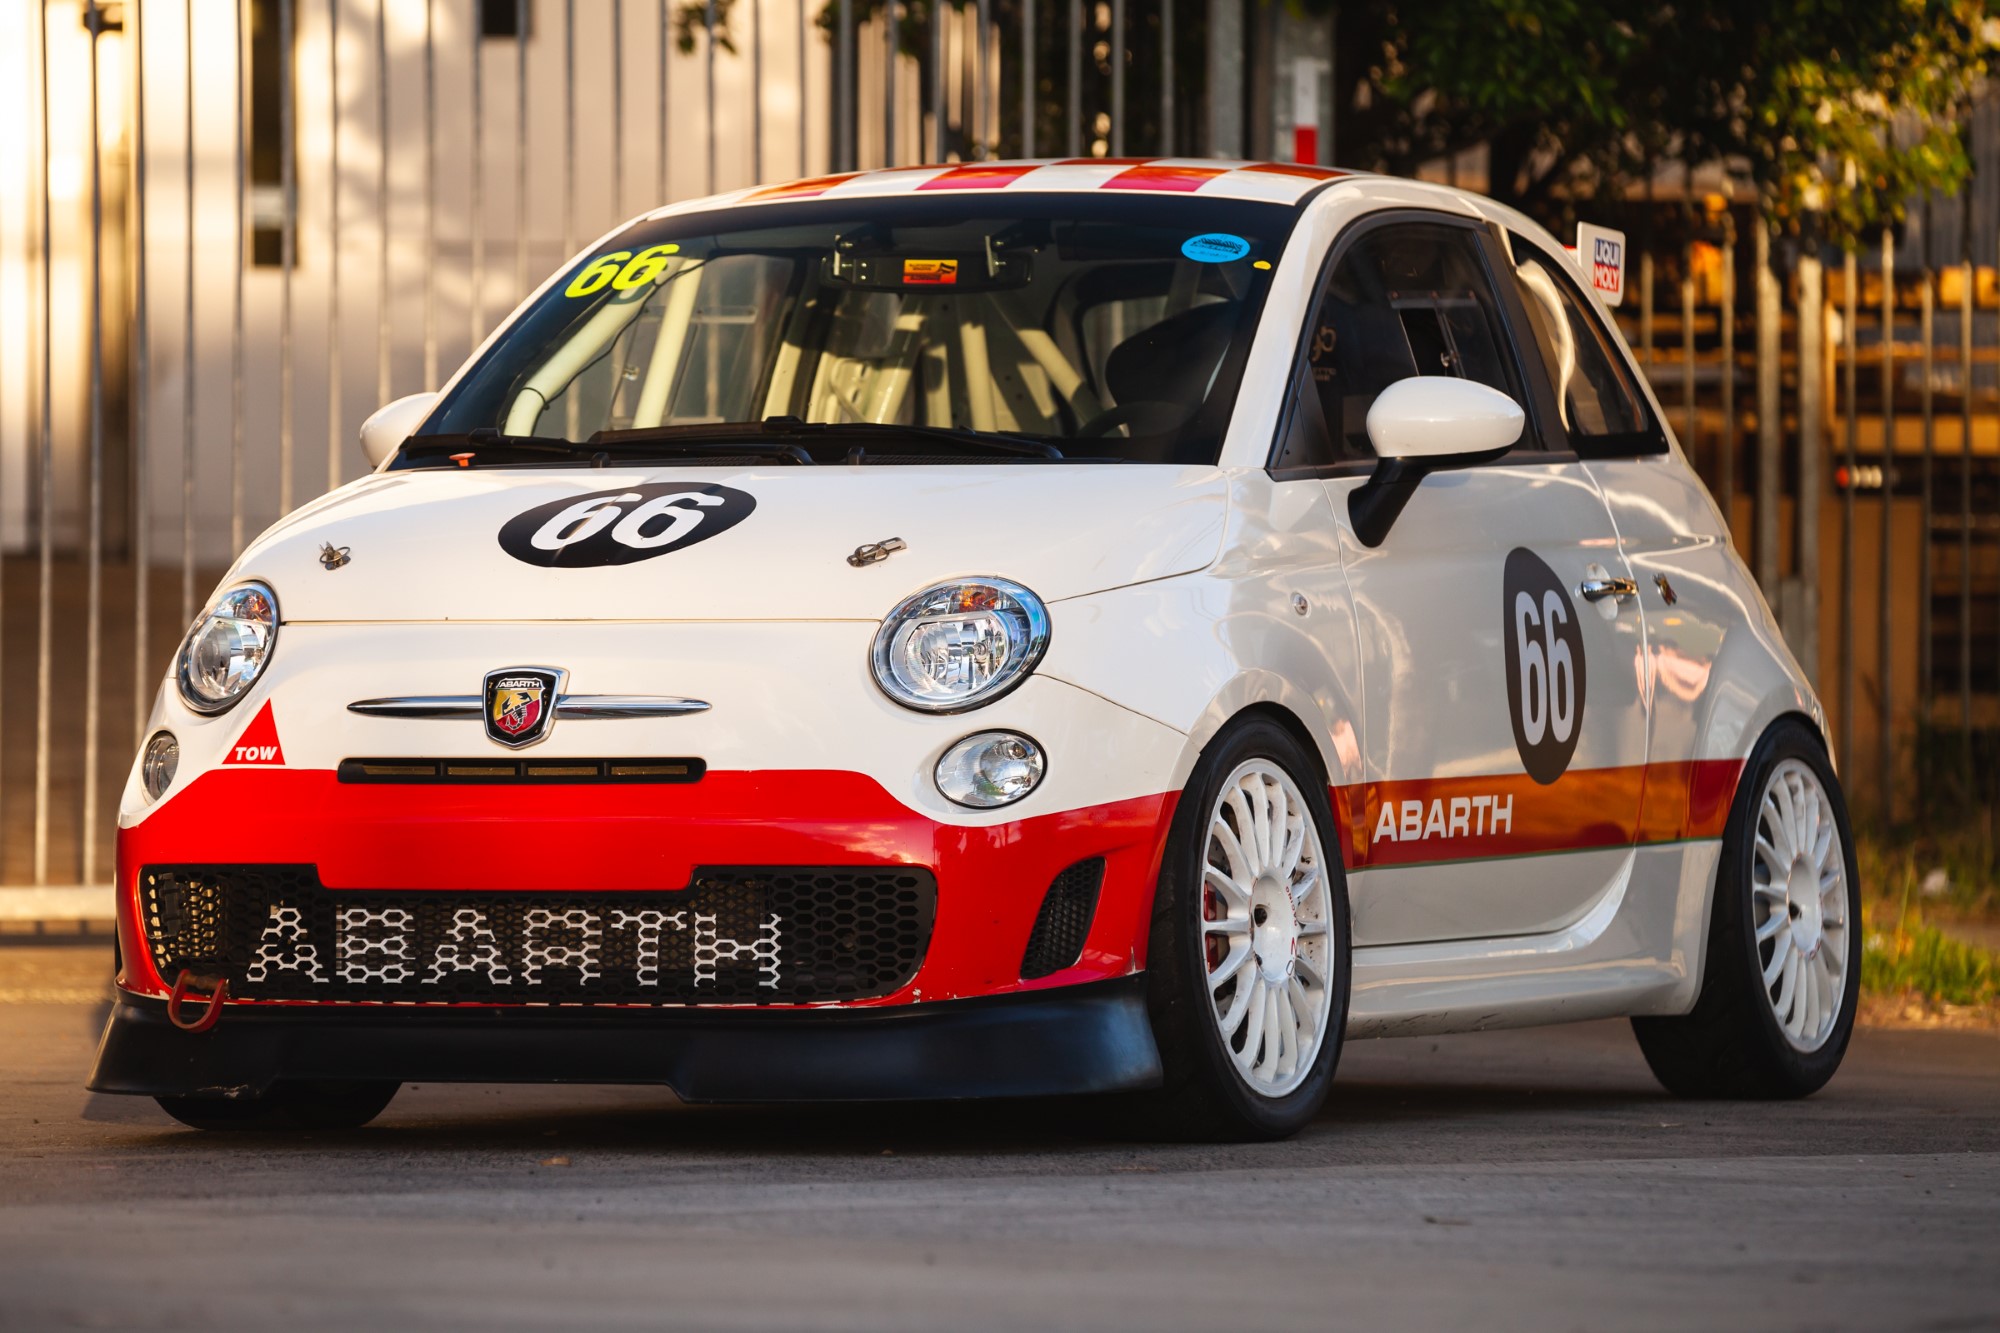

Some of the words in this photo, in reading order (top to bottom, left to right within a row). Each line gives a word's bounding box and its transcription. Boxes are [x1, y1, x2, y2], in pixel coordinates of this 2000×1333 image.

[564, 244, 680, 298] 66
[1594, 265, 1619, 291] MOLY
[1595, 239, 1621, 267] LIQUI
[531, 492, 725, 551] 66
[1515, 589, 1575, 746] 66
[235, 746, 278, 761] TOW
[1372, 794, 1513, 844] ABARTH
[246, 905, 782, 989] ABARTH
